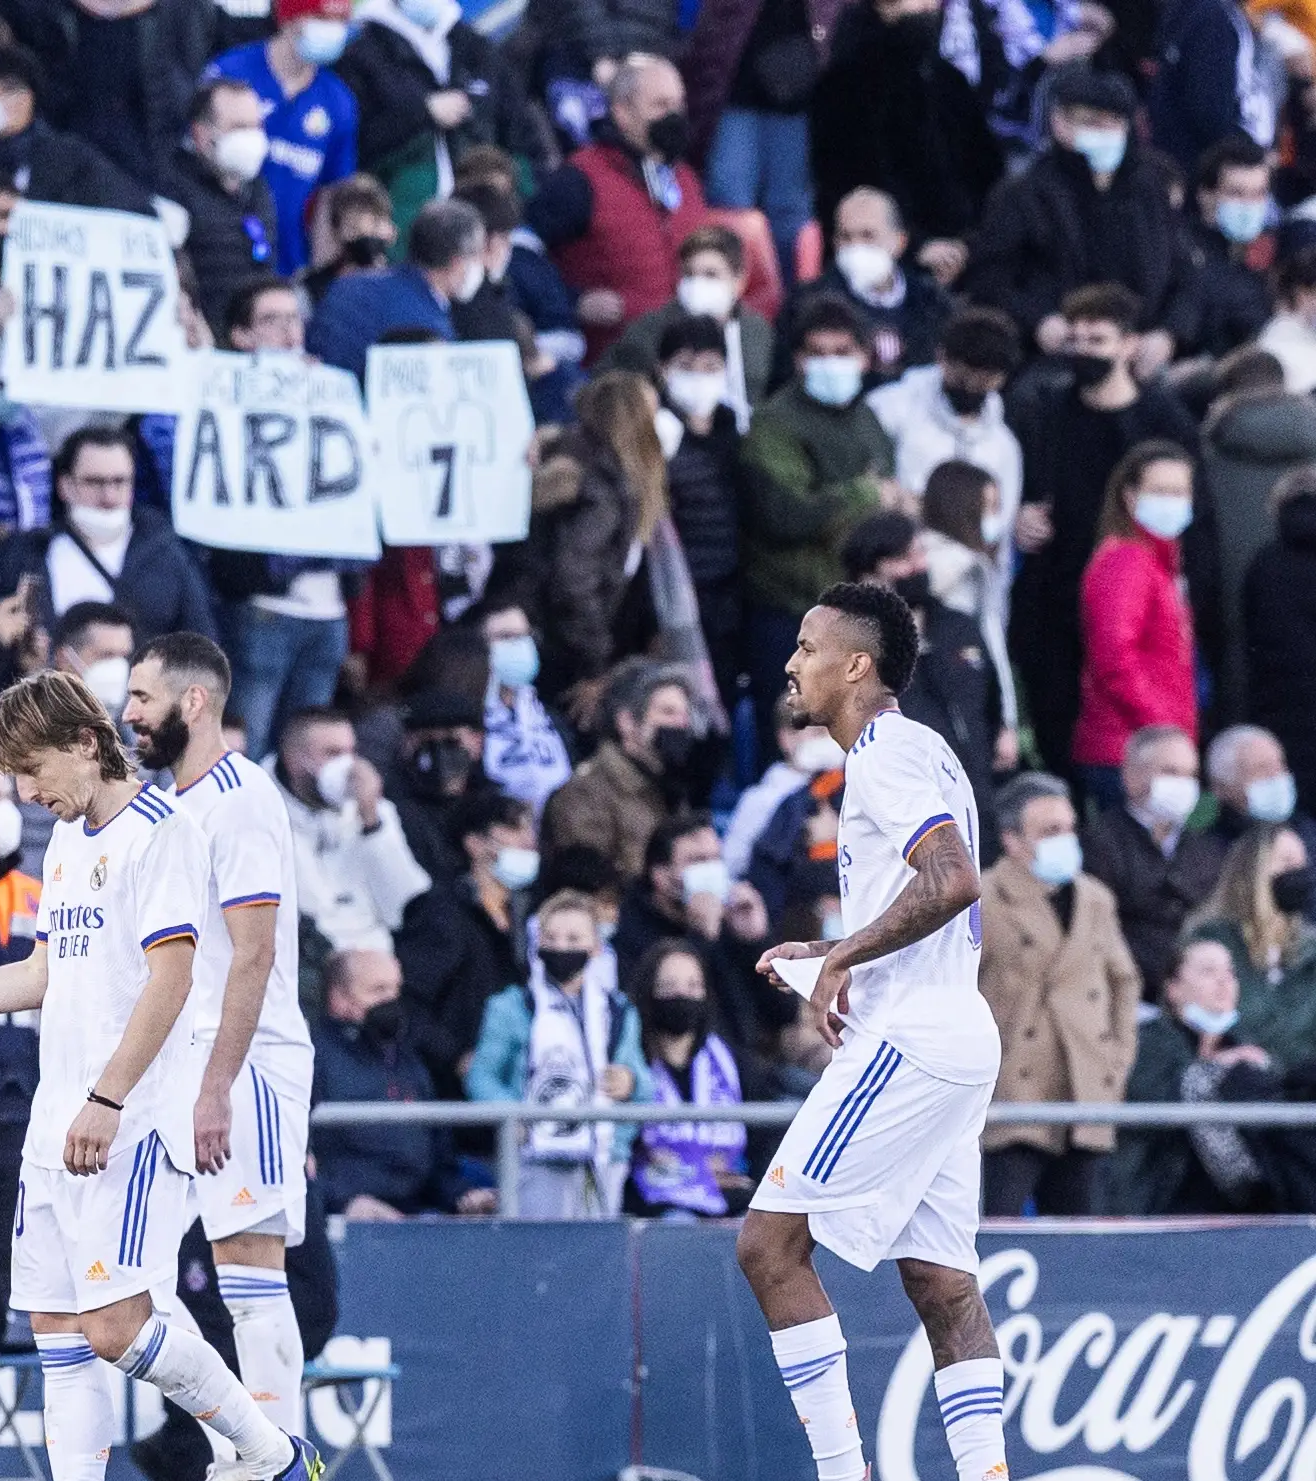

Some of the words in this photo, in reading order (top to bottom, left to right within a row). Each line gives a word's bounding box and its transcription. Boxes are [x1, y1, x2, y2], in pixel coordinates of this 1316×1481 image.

[23, 263, 167, 370] HAZ
[184, 407, 362, 509] ARD
[430, 445, 455, 520] 7
[48, 901, 105, 931] mirtes
